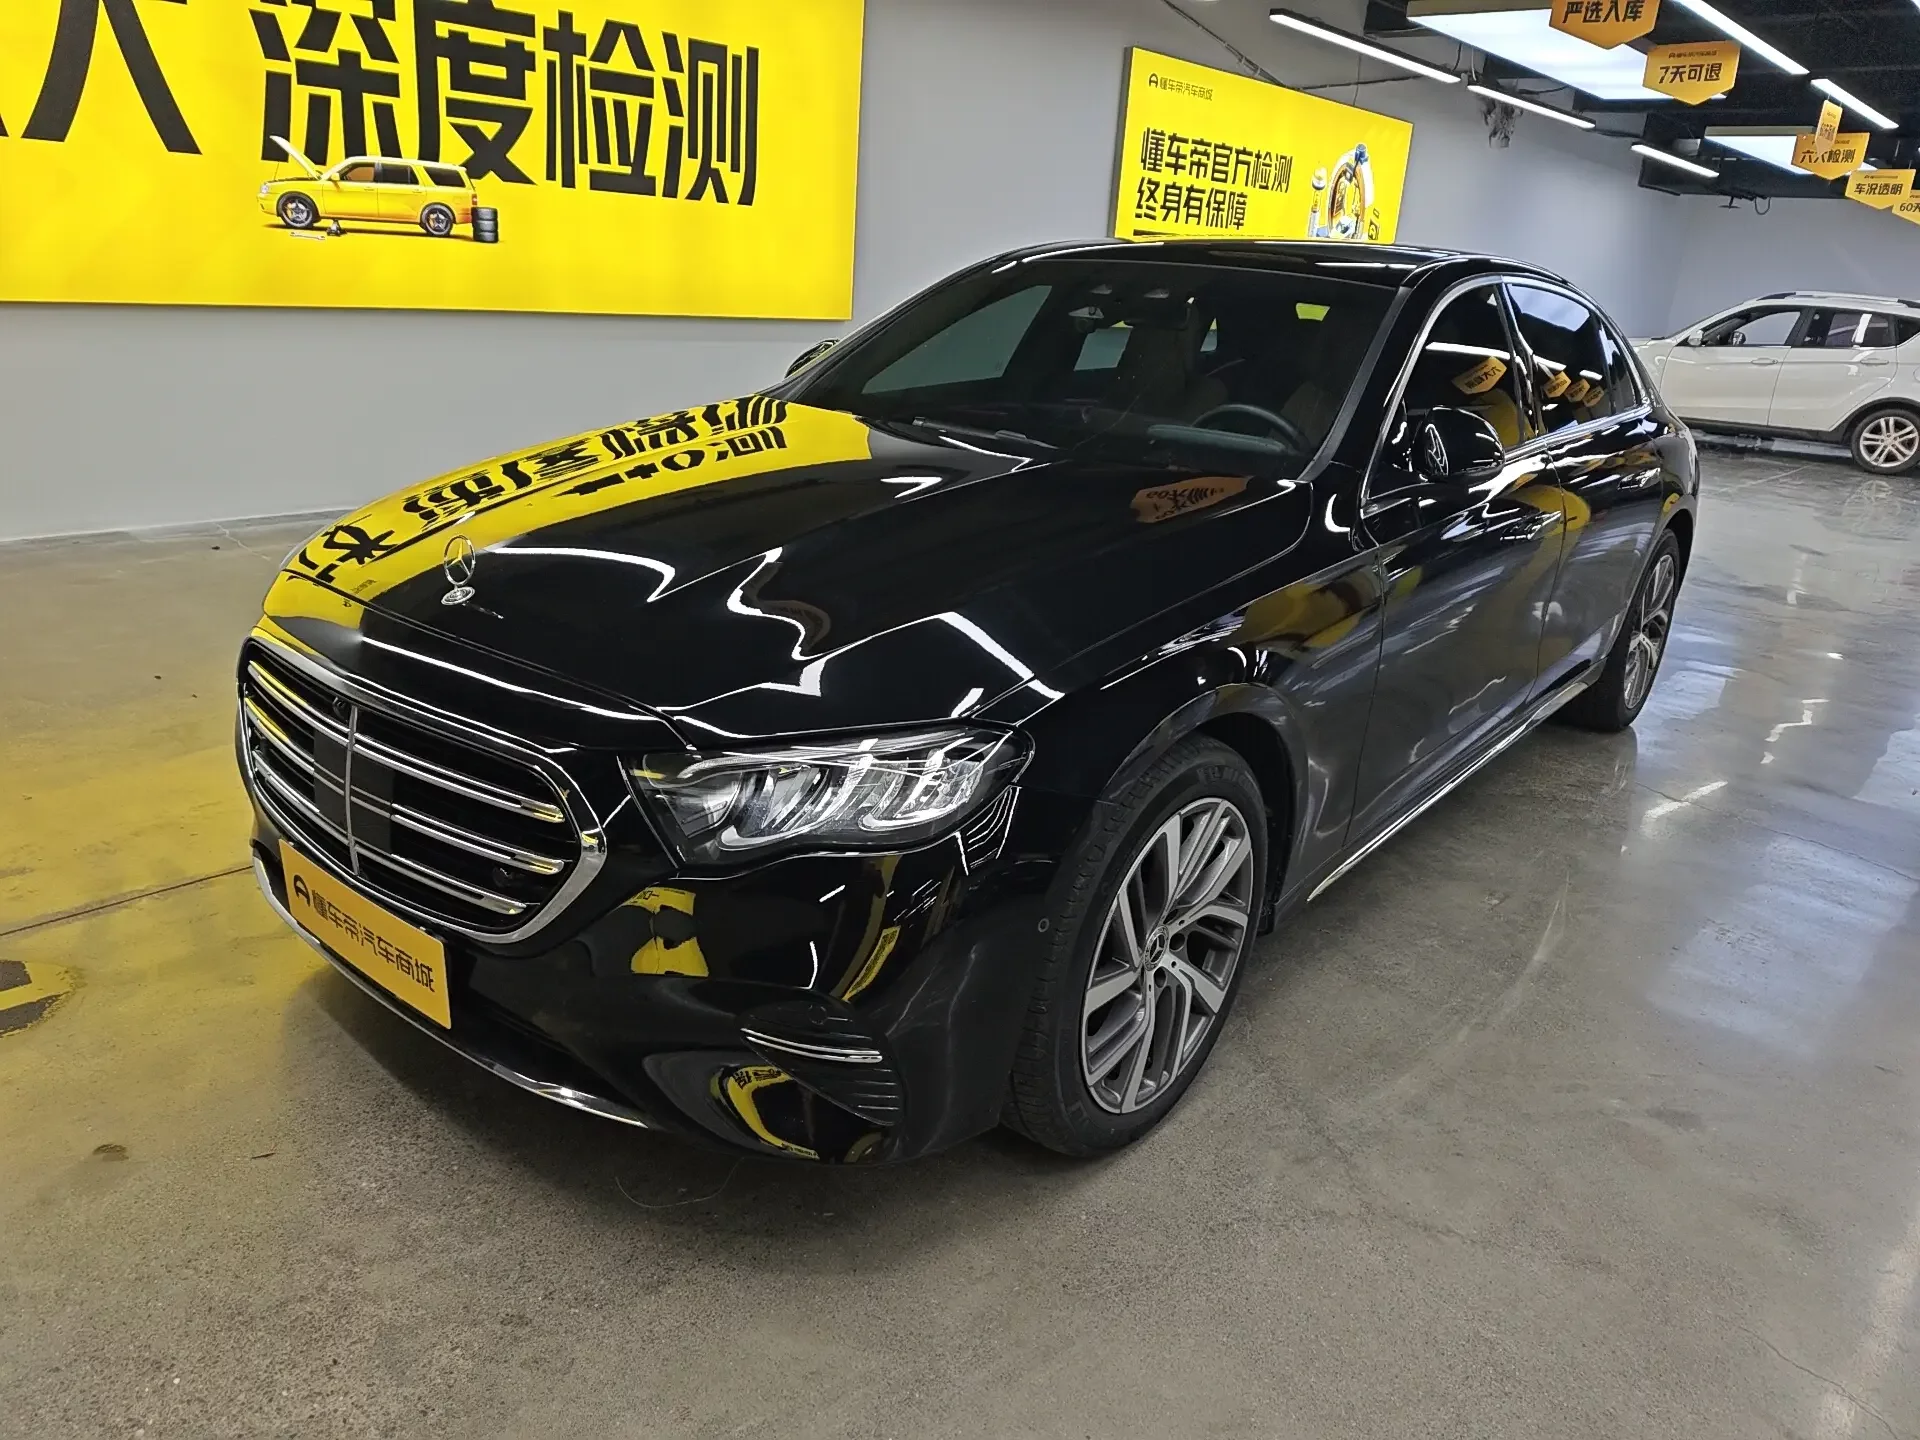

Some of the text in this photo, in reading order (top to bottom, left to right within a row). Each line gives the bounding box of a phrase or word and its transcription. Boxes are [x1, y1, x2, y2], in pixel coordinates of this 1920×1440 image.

[1562, 0, 1645, 24] 严选入库
[1159, 76, 1214, 102] 懂车帝汽车商城
[1658, 63, 1723, 85] 7天可退
[248, 0, 760, 206] 深度检测
[1140, 127, 1293, 193] 懂车帝官方检测
[1135, 177, 1248, 231] 终身有保障
[1854, 183, 1904, 195] 车况透明
[312, 889, 436, 993] 懂车帝汽车商城
